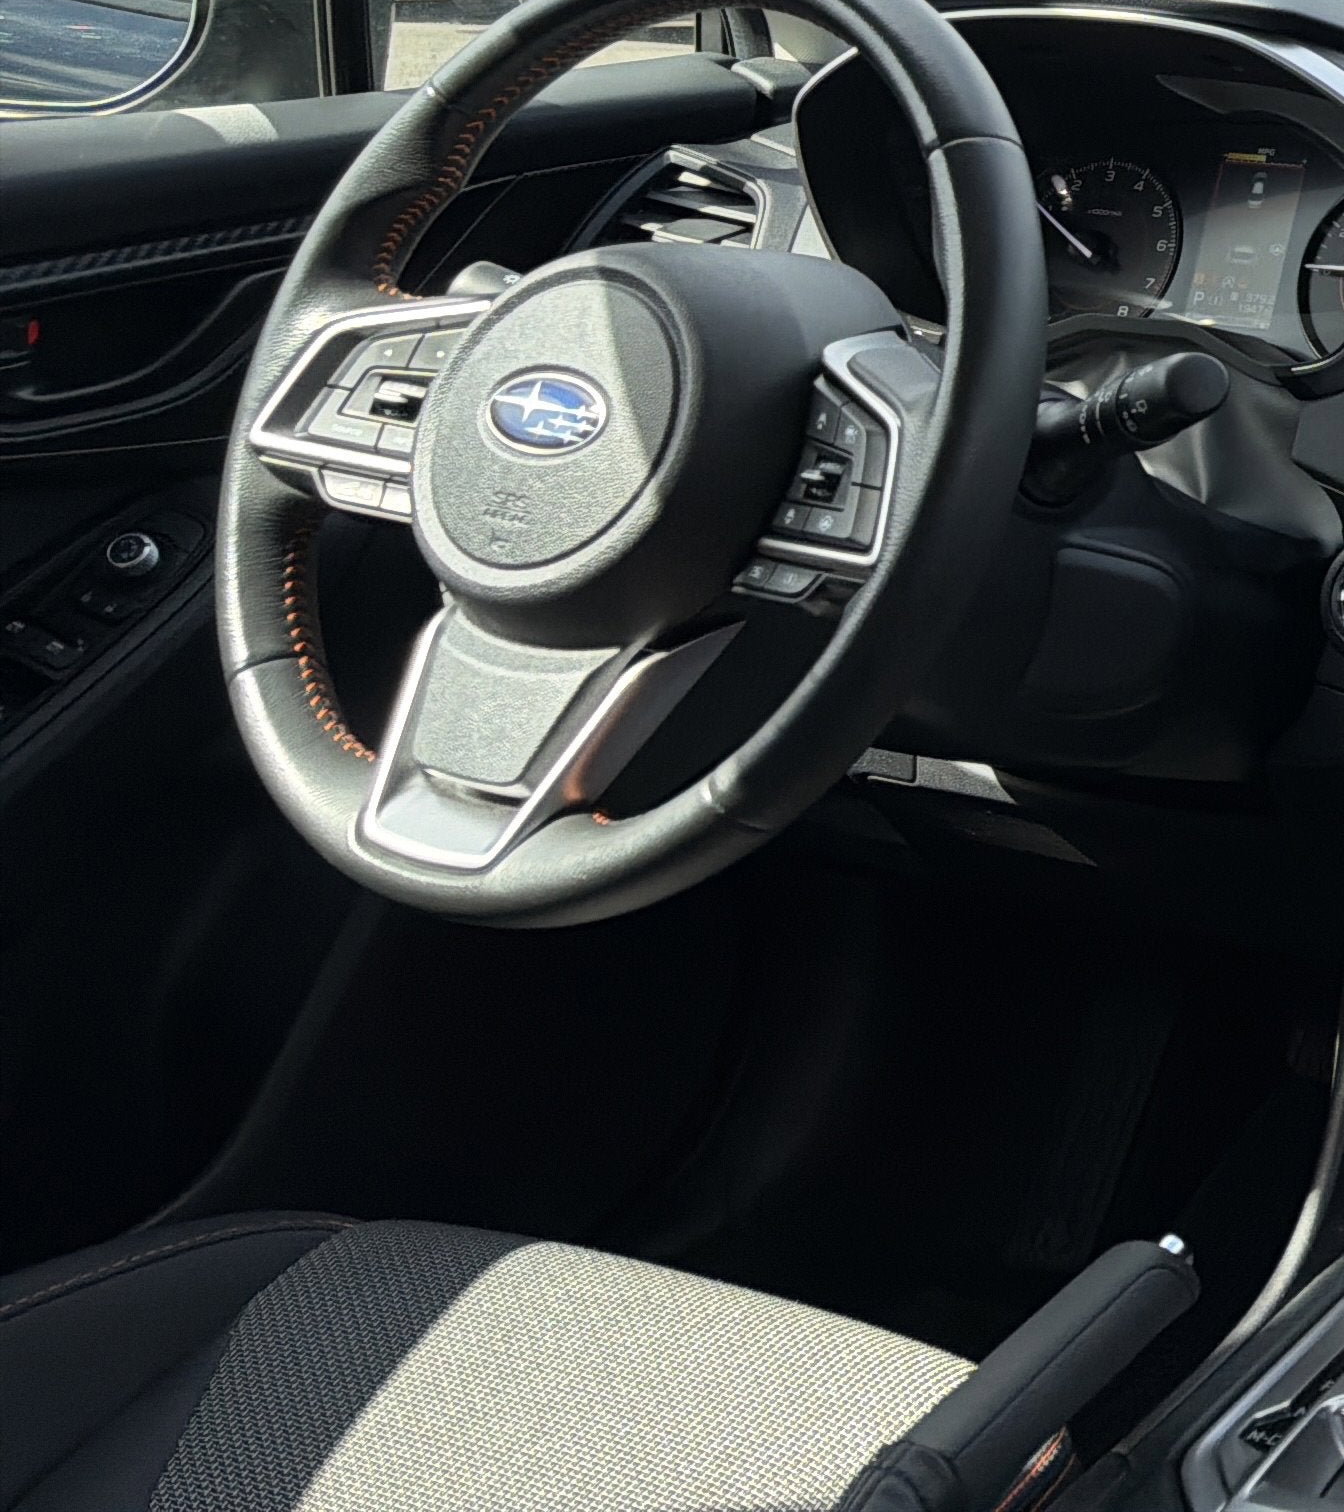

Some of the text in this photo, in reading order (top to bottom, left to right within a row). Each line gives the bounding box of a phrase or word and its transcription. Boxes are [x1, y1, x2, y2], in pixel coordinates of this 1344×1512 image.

[1105, 171, 1116, 182] 3
[1134, 181, 1145, 192] 4
[1152, 206, 1164, 218] 5
[1156, 240, 1168, 252] 6
[1145, 278, 1156, 289] 7
[1117, 306, 1129, 318] 8
